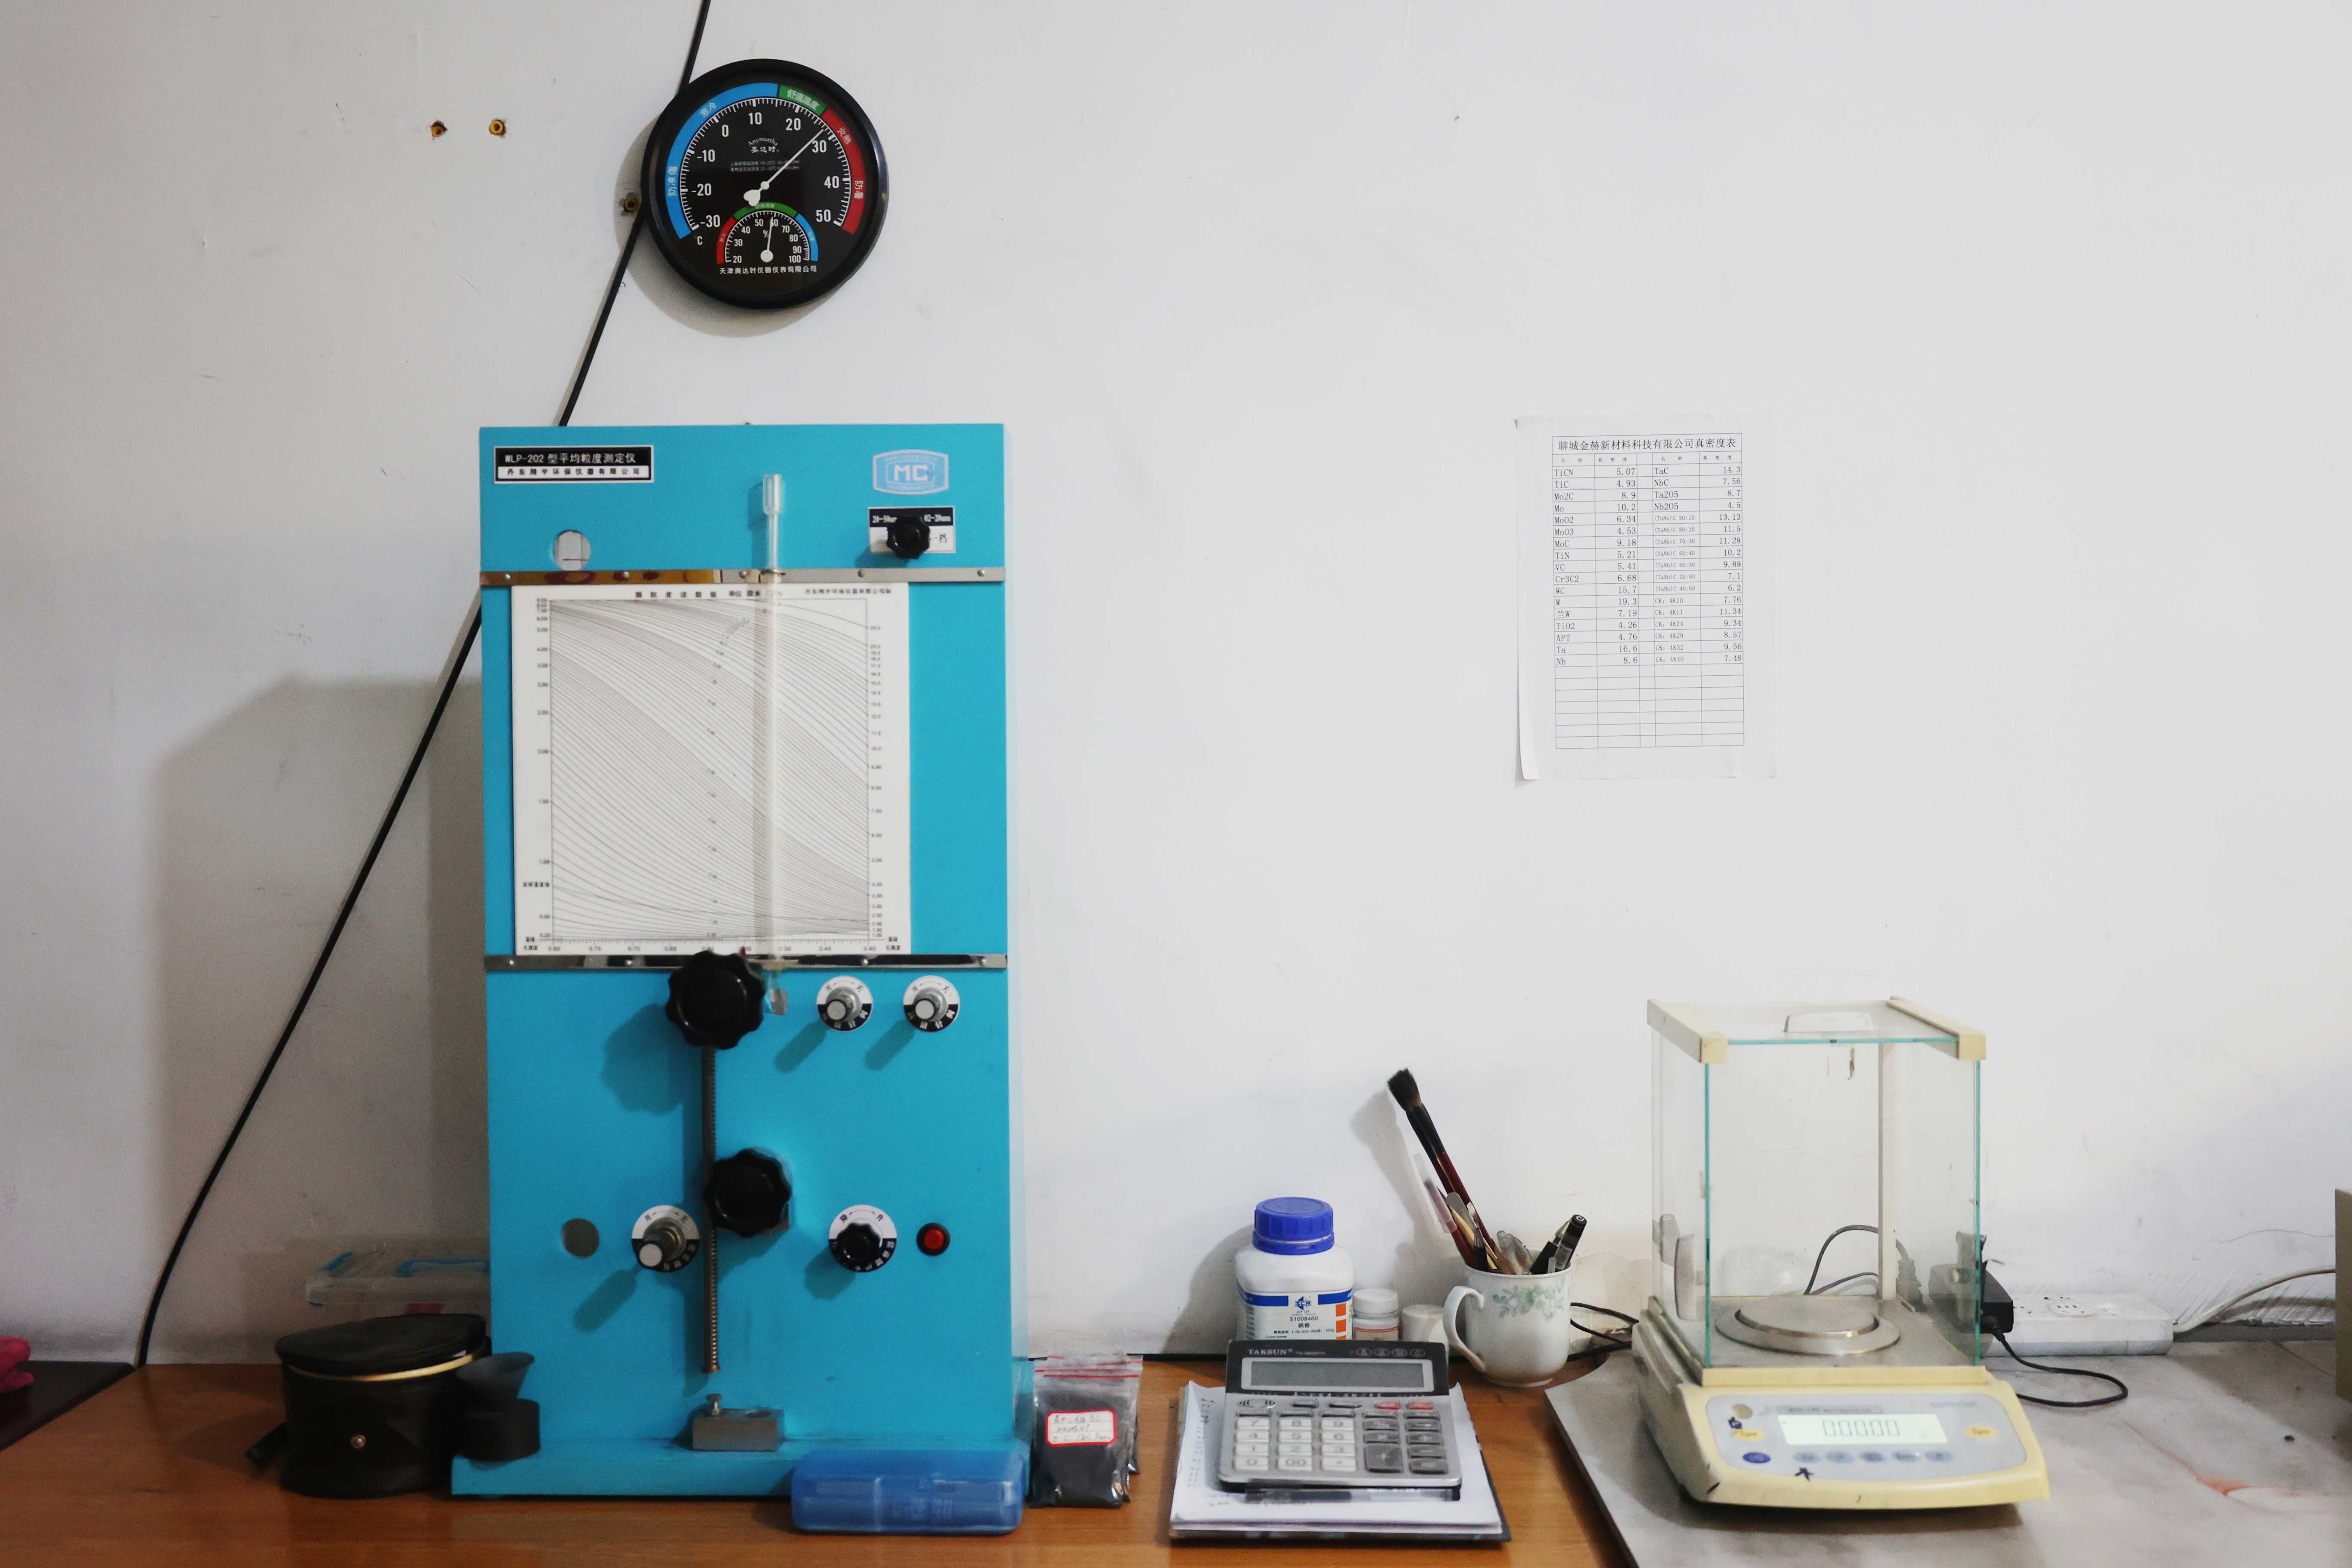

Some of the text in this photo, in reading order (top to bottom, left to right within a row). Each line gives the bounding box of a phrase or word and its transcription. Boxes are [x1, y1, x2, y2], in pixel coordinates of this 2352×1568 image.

[748, 112, 763, 125] 10
[786, 118, 801, 131] 20
[722, 125, 729, 137] 0
[812, 140, 827, 153] 30
[697, 150, 715, 162] -10
[824, 176, 839, 189] 40
[692, 183, 711, 196] -20
[816, 209, 831, 222] 50
[700, 215, 720, 227] -30
[754, 219, 764, 227] 50
[781, 225, 790, 233] 70
[789, 234, 798, 242] 80
[1559, 438, 1736, 450] 聊城金赫新材料科技有限公司真密度表
[505, 454, 544, 463] WLP-202
[894, 464, 928, 481] MC
[1554, 469, 1574, 477] TiCN
[1616, 468, 1635, 476] 5.07
[1654, 467, 1669, 475] TaC
[1554, 481, 1569, 489] TiC
[1616, 479, 1636, 488] 4.93
[1654, 478, 1669, 487] NbC
[1554, 492, 1574, 500] Mo2C
[1554, 504, 1564, 512] Mo
[1617, 503, 1636, 511] 10.2
[1617, 515, 1636, 523] 6.34
[1616, 527, 1636, 535] 4.53
[1555, 540, 1570, 548] MoC
[1617, 539, 1636, 547] 9.18
[1555, 551, 1570, 560] TiN
[1617, 550, 1636, 559] 5.21
[1617, 562, 1636, 570] 5.41
[1555, 575, 1580, 583] Cr3C2
[1617, 574, 1637, 582] 6.68
[1618, 585, 1637, 594] 15.7
[1618, 597, 1637, 606] 19.3
[1724, 595, 1742, 603] 7.76
[1617, 609, 1637, 617] 7.19
[1618, 621, 1637, 629] 4.26
[1618, 632, 1638, 640] 4.76
